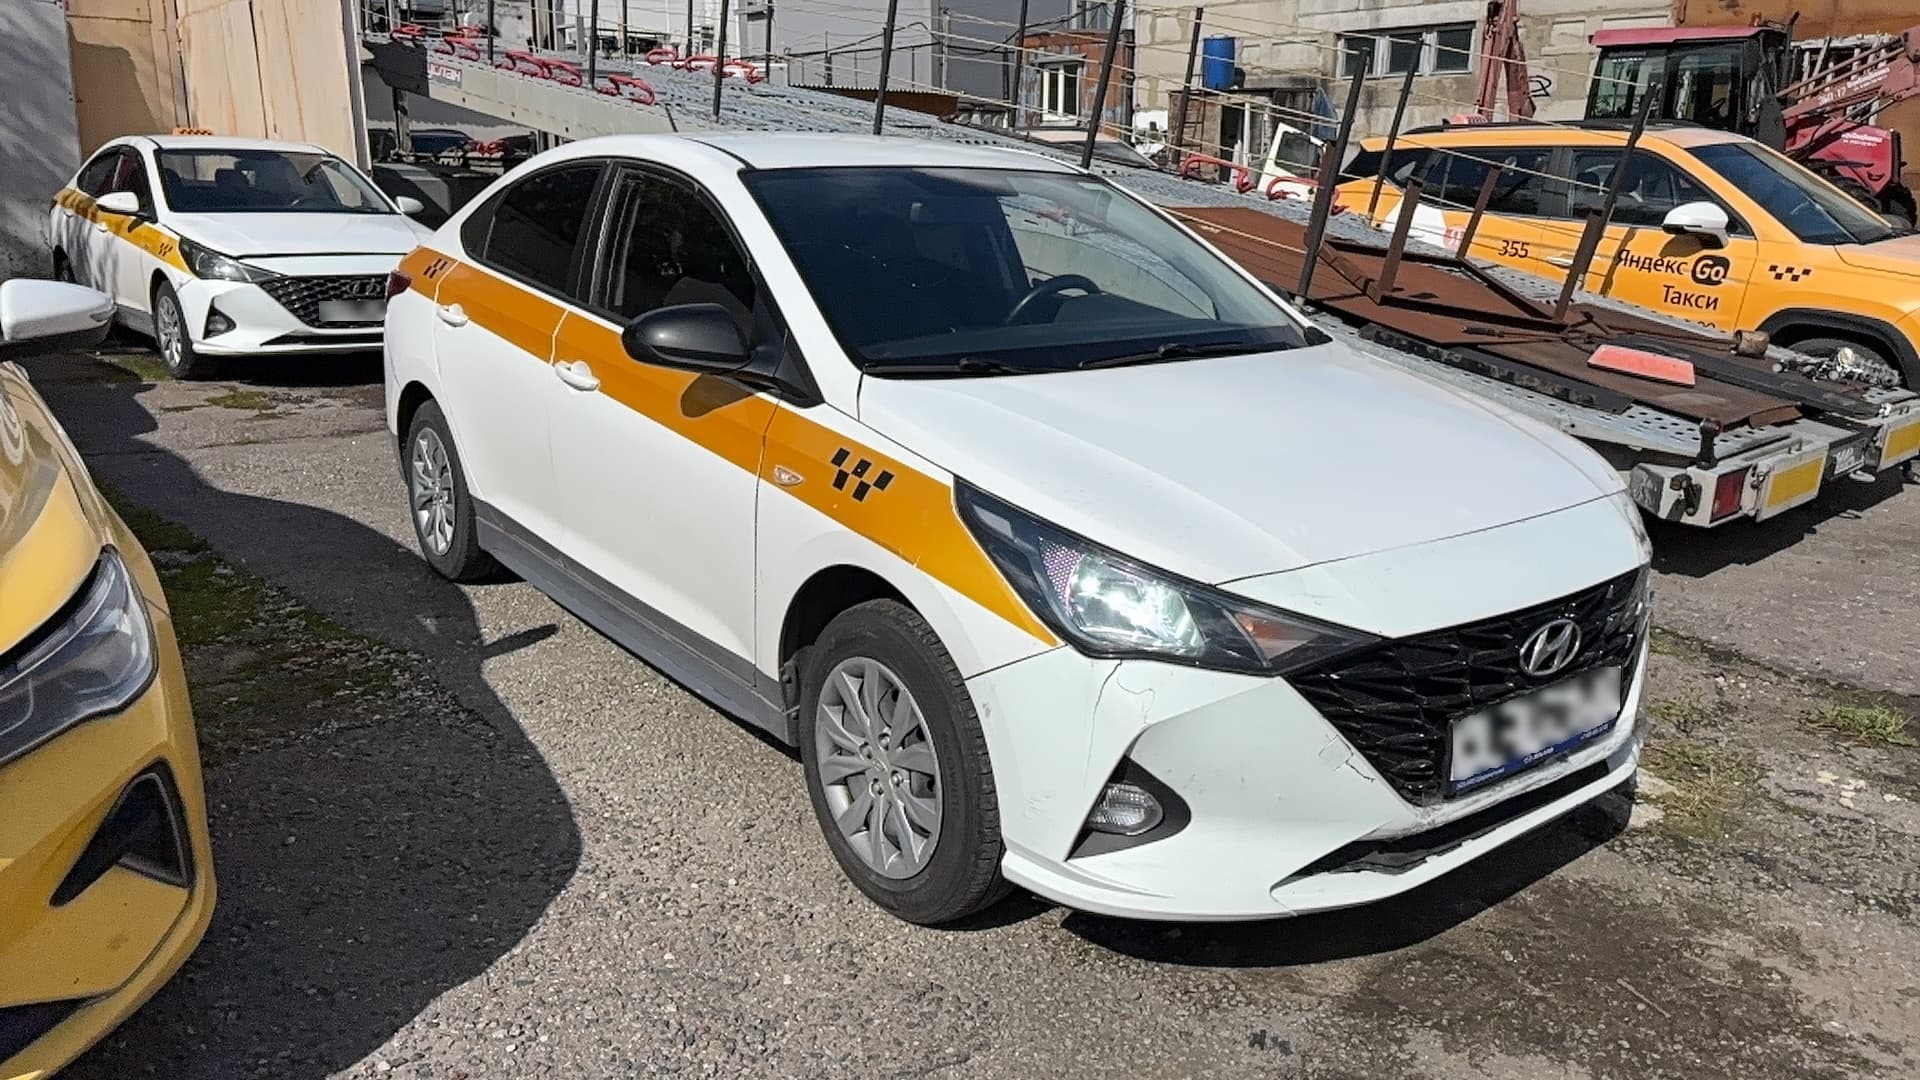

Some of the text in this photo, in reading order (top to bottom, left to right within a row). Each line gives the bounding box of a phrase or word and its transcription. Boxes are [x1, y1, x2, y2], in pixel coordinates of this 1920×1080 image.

[1498, 239, 1530, 258] 355
[1615, 249, 1725, 281] Яндекс Go
[1663, 284, 1719, 311] Такси
